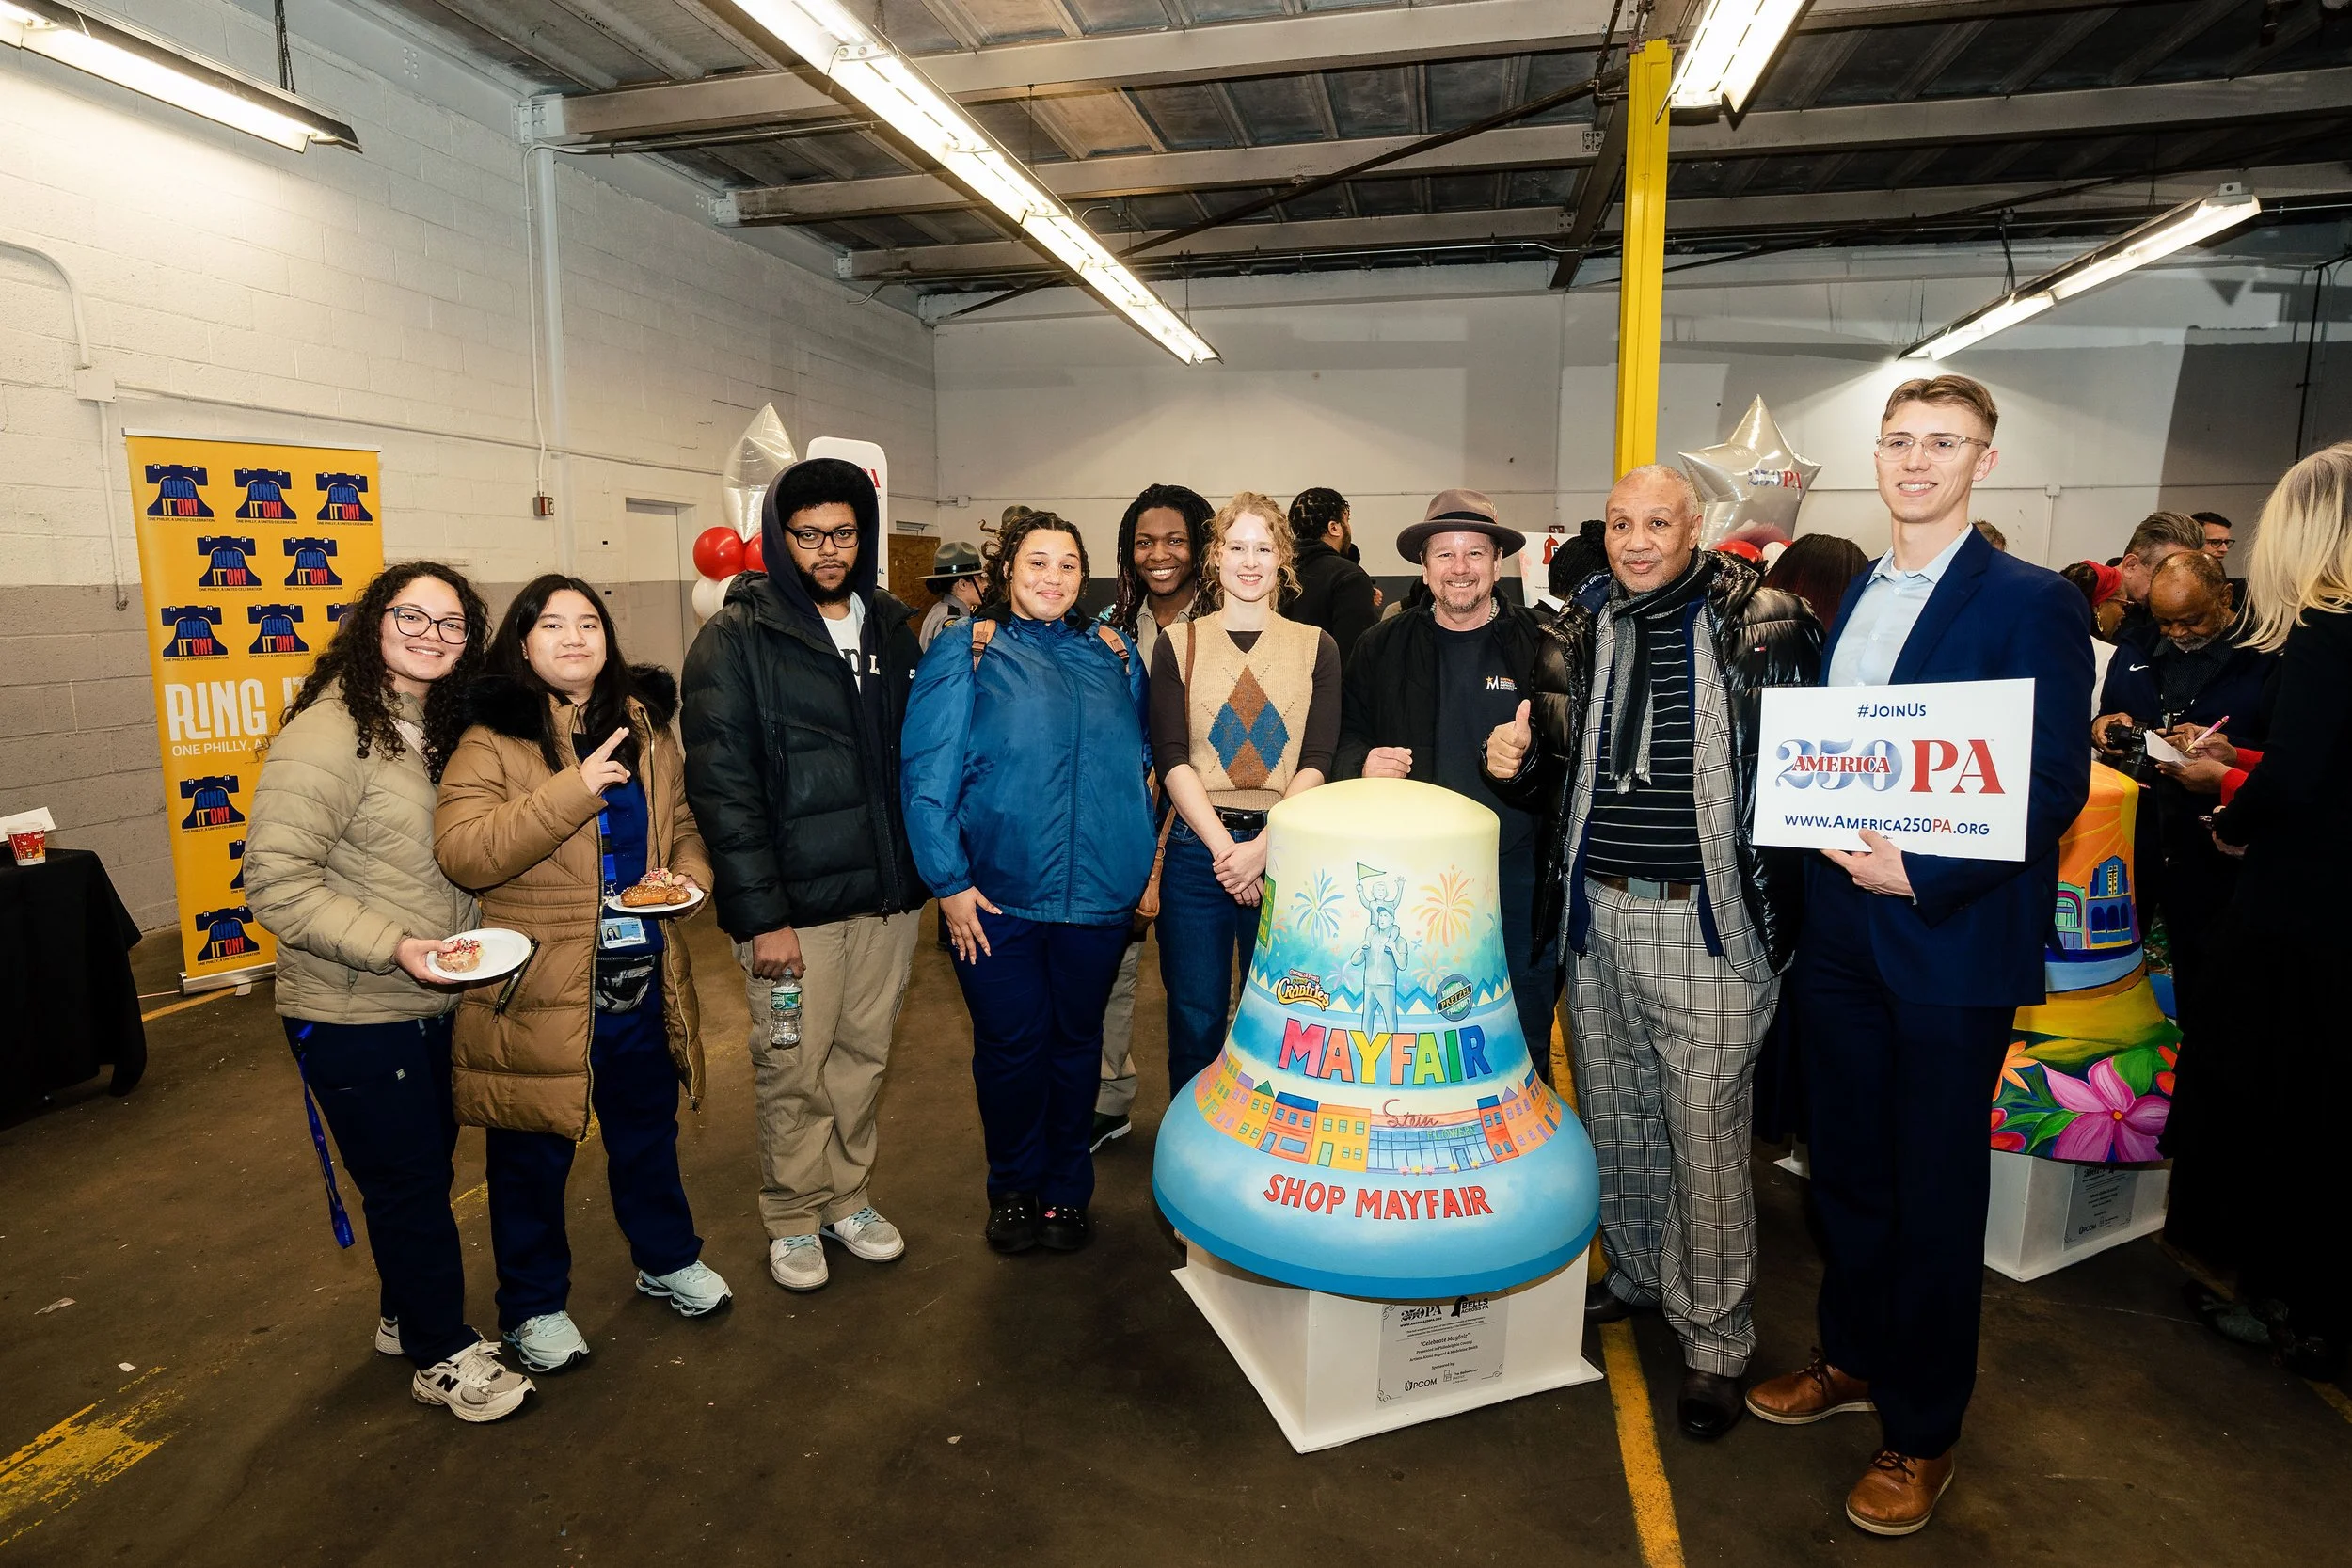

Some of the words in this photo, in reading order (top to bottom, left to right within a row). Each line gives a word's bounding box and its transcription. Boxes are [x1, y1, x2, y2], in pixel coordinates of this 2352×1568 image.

[1783, 470, 1802, 489] PA
[163, 480, 194, 498] RING
[250, 483, 278, 500] RING
[330, 487, 357, 503] RING
[162, 499, 177, 515] IT
[177, 499, 198, 515] ON!
[249, 501, 262, 517] IT
[262, 501, 282, 517] ON!
[329, 504, 342, 519] IT
[342, 504, 359, 519] ON!
[214, 551, 243, 568] RING
[298, 551, 326, 568] RING
[213, 569, 227, 585] IT
[227, 568, 246, 585] ON!
[297, 569, 310, 584] IT
[310, 569, 327, 585] ON!
[179, 621, 209, 638] RING
[263, 618, 291, 635] RING
[178, 639, 192, 656] IT
[192, 639, 213, 655] ON!
[262, 636, 276, 652] IT
[276, 635, 294, 651] ON!
[165, 678, 268, 742] RING
[172, 743, 201, 756] ONE
[203, 739, 251, 754] PHILLY,
[1775, 738, 1903, 792] 250
[1910, 739, 2006, 794] PA
[1791, 755, 1891, 774] AMERICA
[197, 790, 226, 809] RING
[196, 809, 210, 826] IT
[210, 807, 230, 824] ON!
[212, 922, 241, 941] RING
[211, 941, 225, 958] IT
[225, 937, 244, 955] ON!
[1440, 987, 1471, 1009] PRETZEL
[1277, 1017, 1492, 1085] MAYFAIR
[1426, 1125, 1476, 1141] FLOWERS
[1263, 1173, 1346, 1217] SHOP
[1355, 1184, 1494, 1220] MAYFAIR
[1425, 1305, 1442, 1317] PA
[1462, 1298, 1488, 1309] BELLS
[436, 1373, 460, 1393] N
